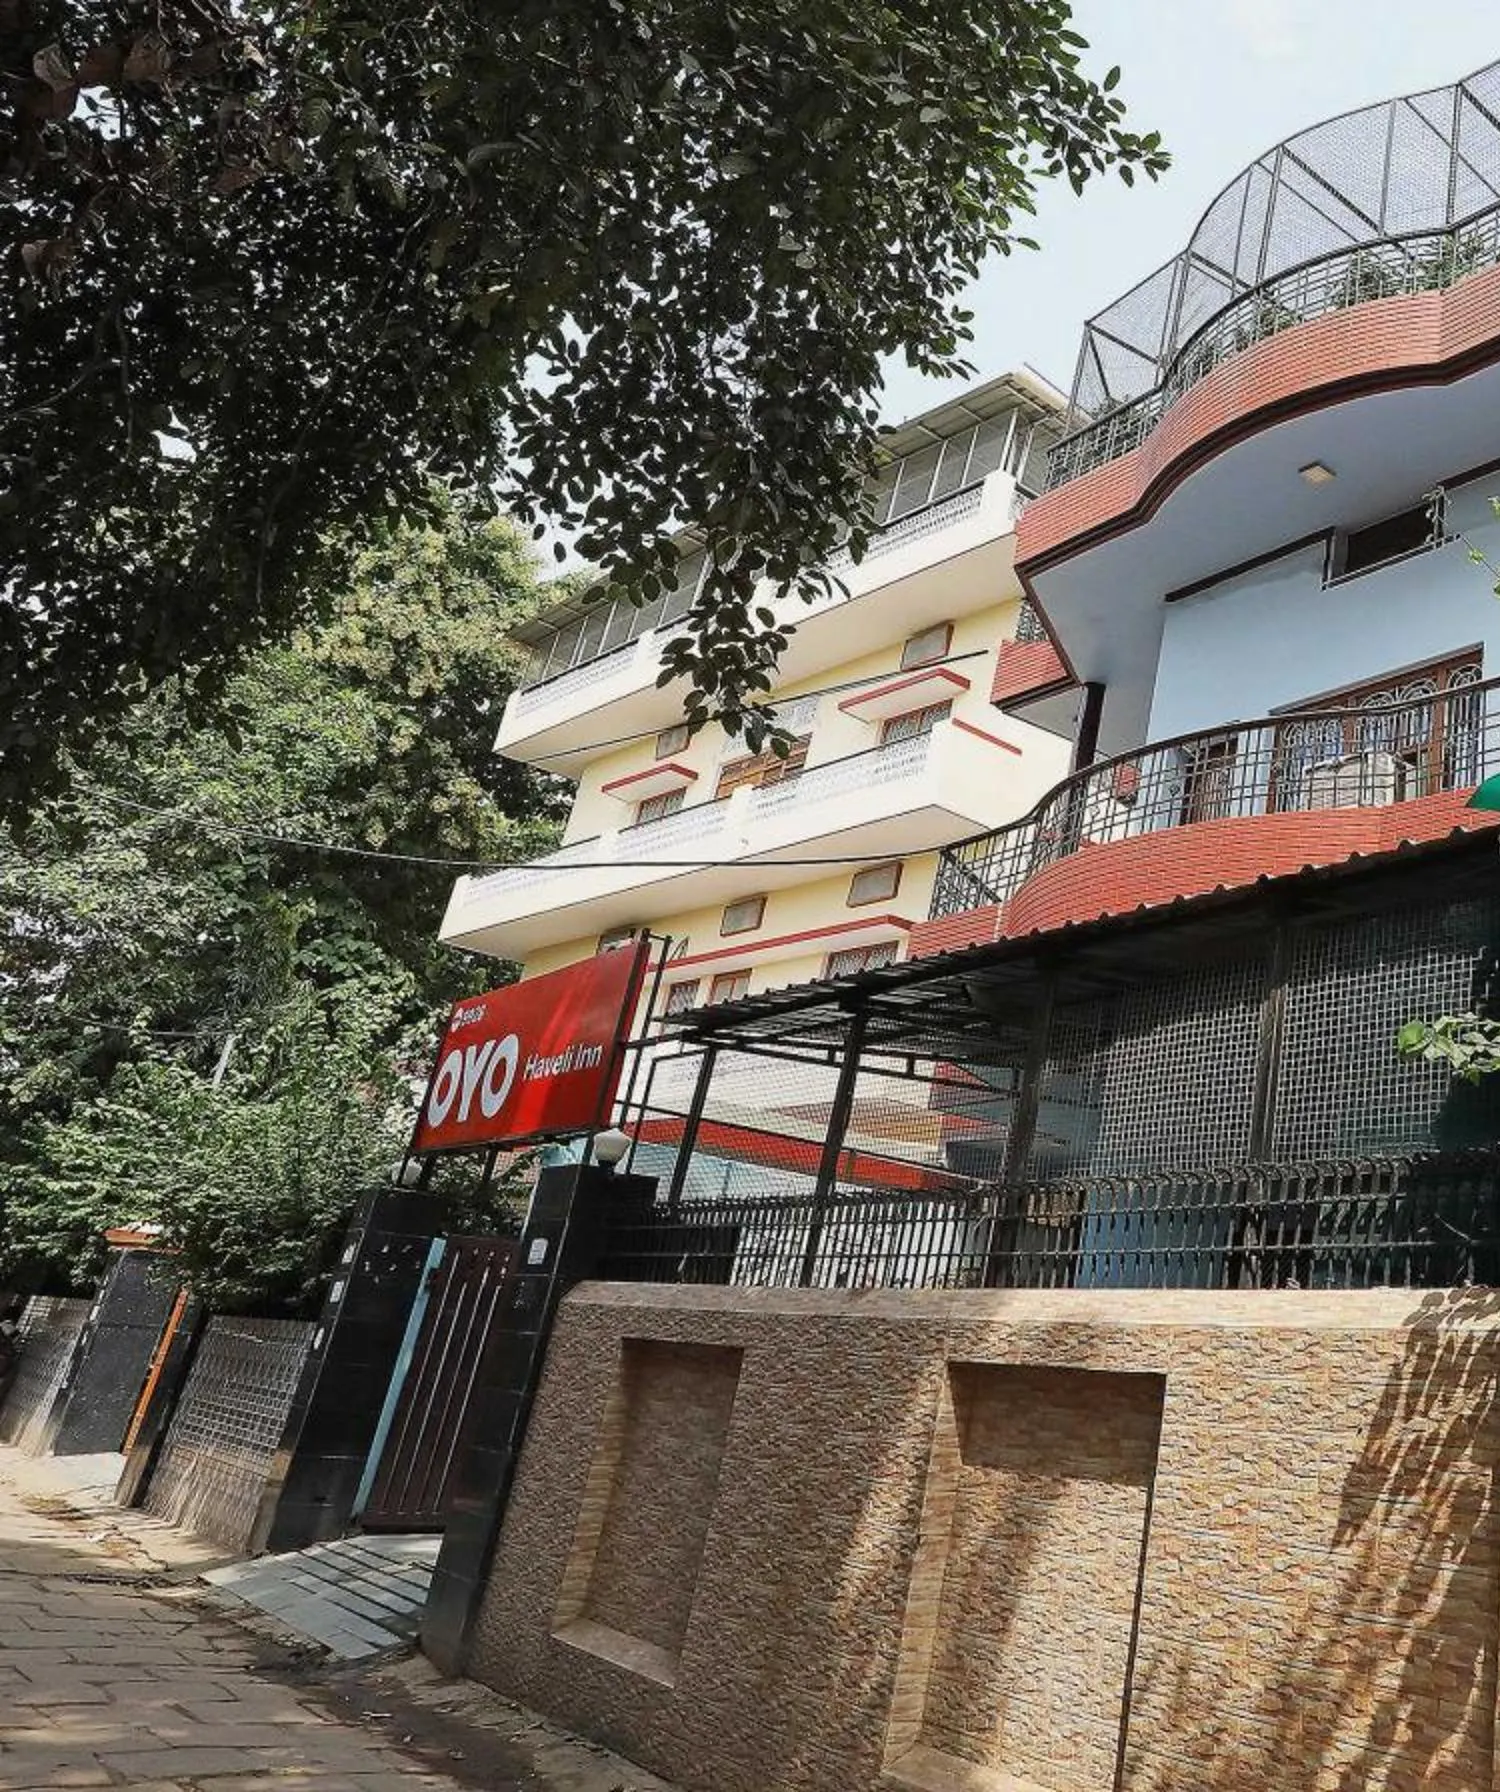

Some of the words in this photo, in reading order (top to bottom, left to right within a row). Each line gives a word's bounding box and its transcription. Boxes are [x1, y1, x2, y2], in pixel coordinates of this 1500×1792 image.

[427, 1033, 519, 1128] OYO
[523, 1044, 573, 1081] Haveli
[574, 1043, 602, 1070] Inn
